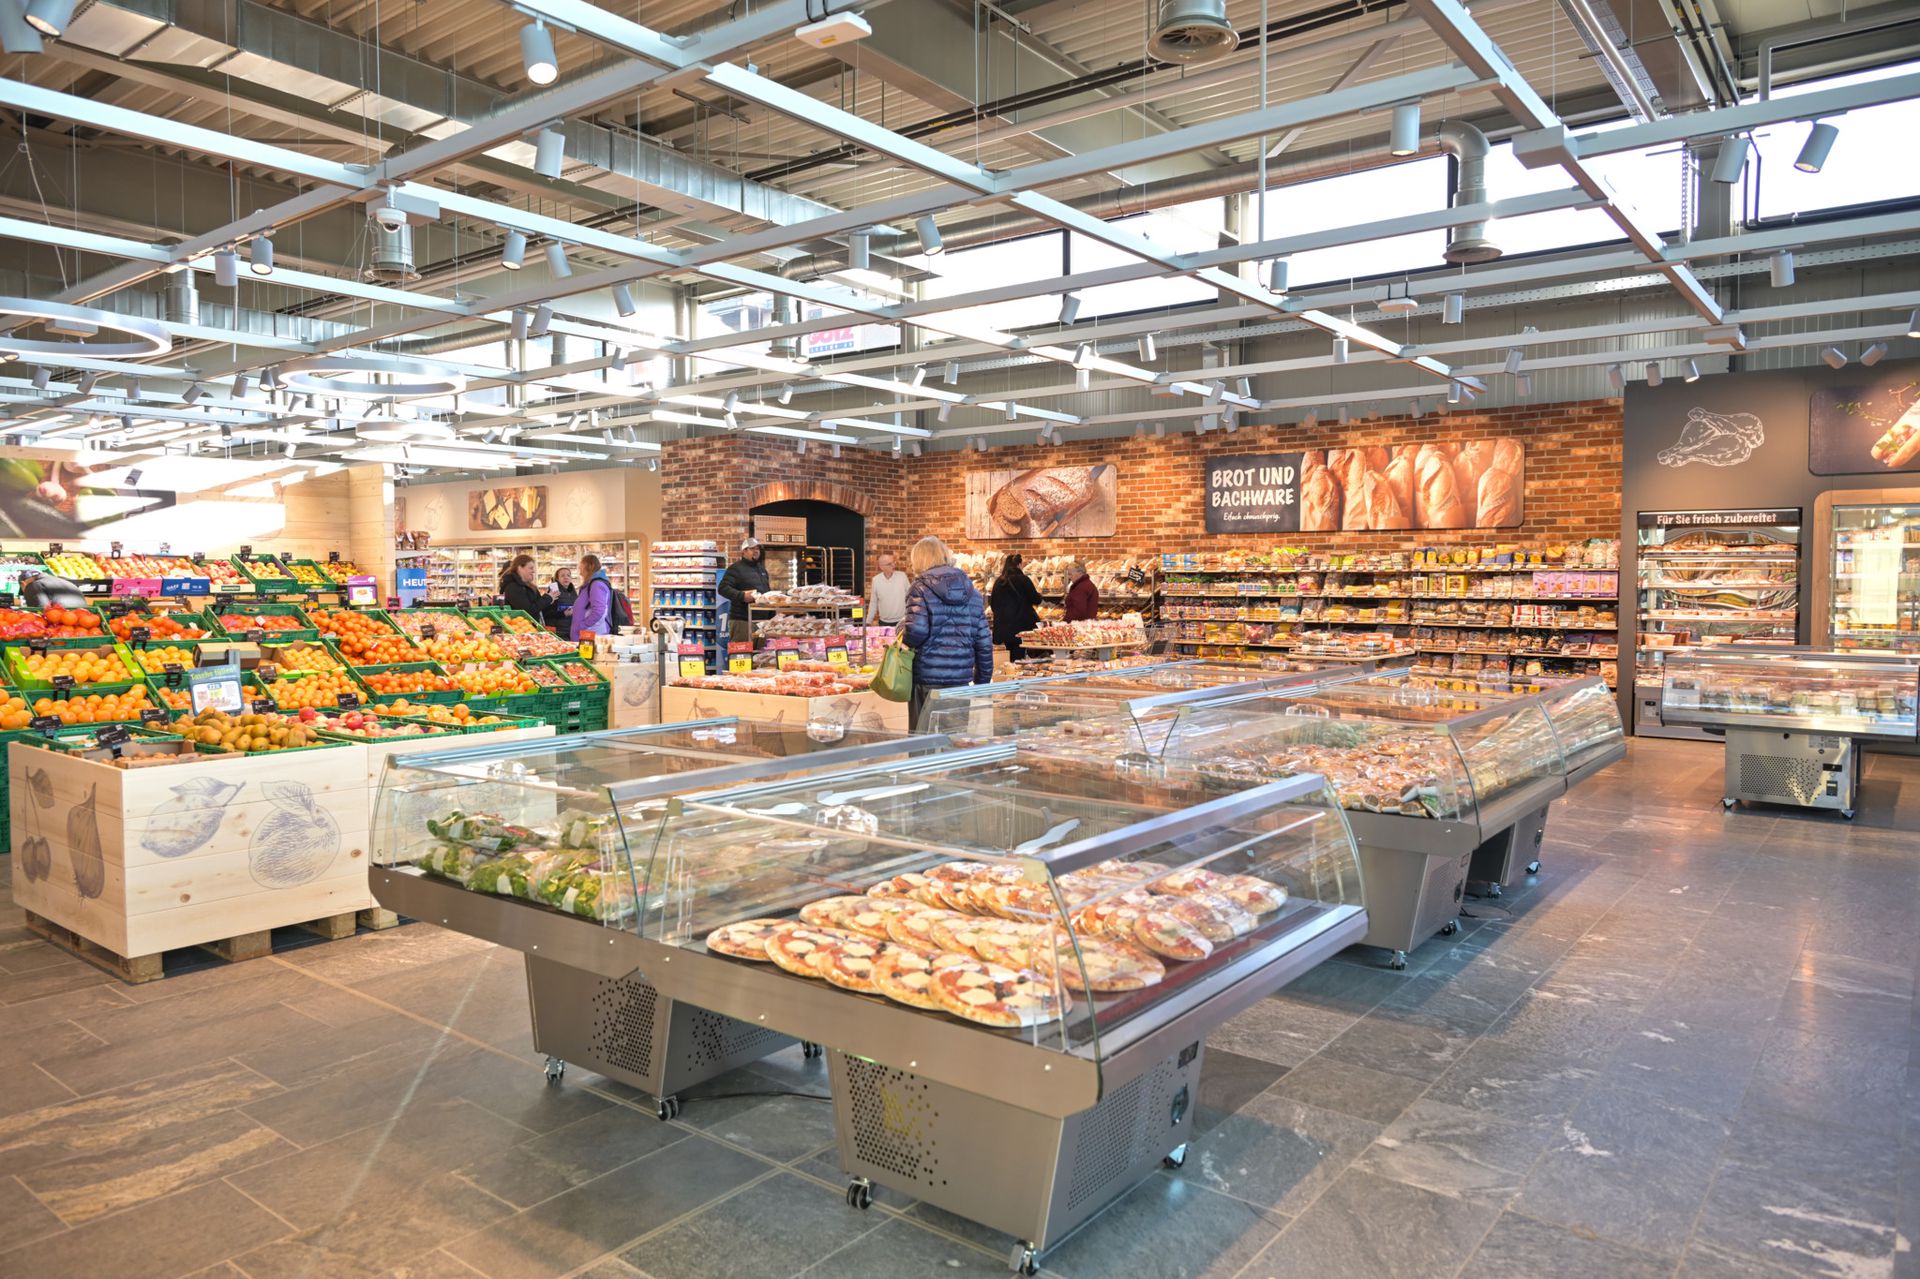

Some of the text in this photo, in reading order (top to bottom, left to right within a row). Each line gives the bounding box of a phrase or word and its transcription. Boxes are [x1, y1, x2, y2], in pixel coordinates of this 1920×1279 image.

[1212, 466, 1294, 488] BROT UND
[1212, 488, 1294, 507] BACHWARE
[1657, 513, 1776, 525] Für Sie frisch zubereitet
[718, 613, 728, 632] 1
